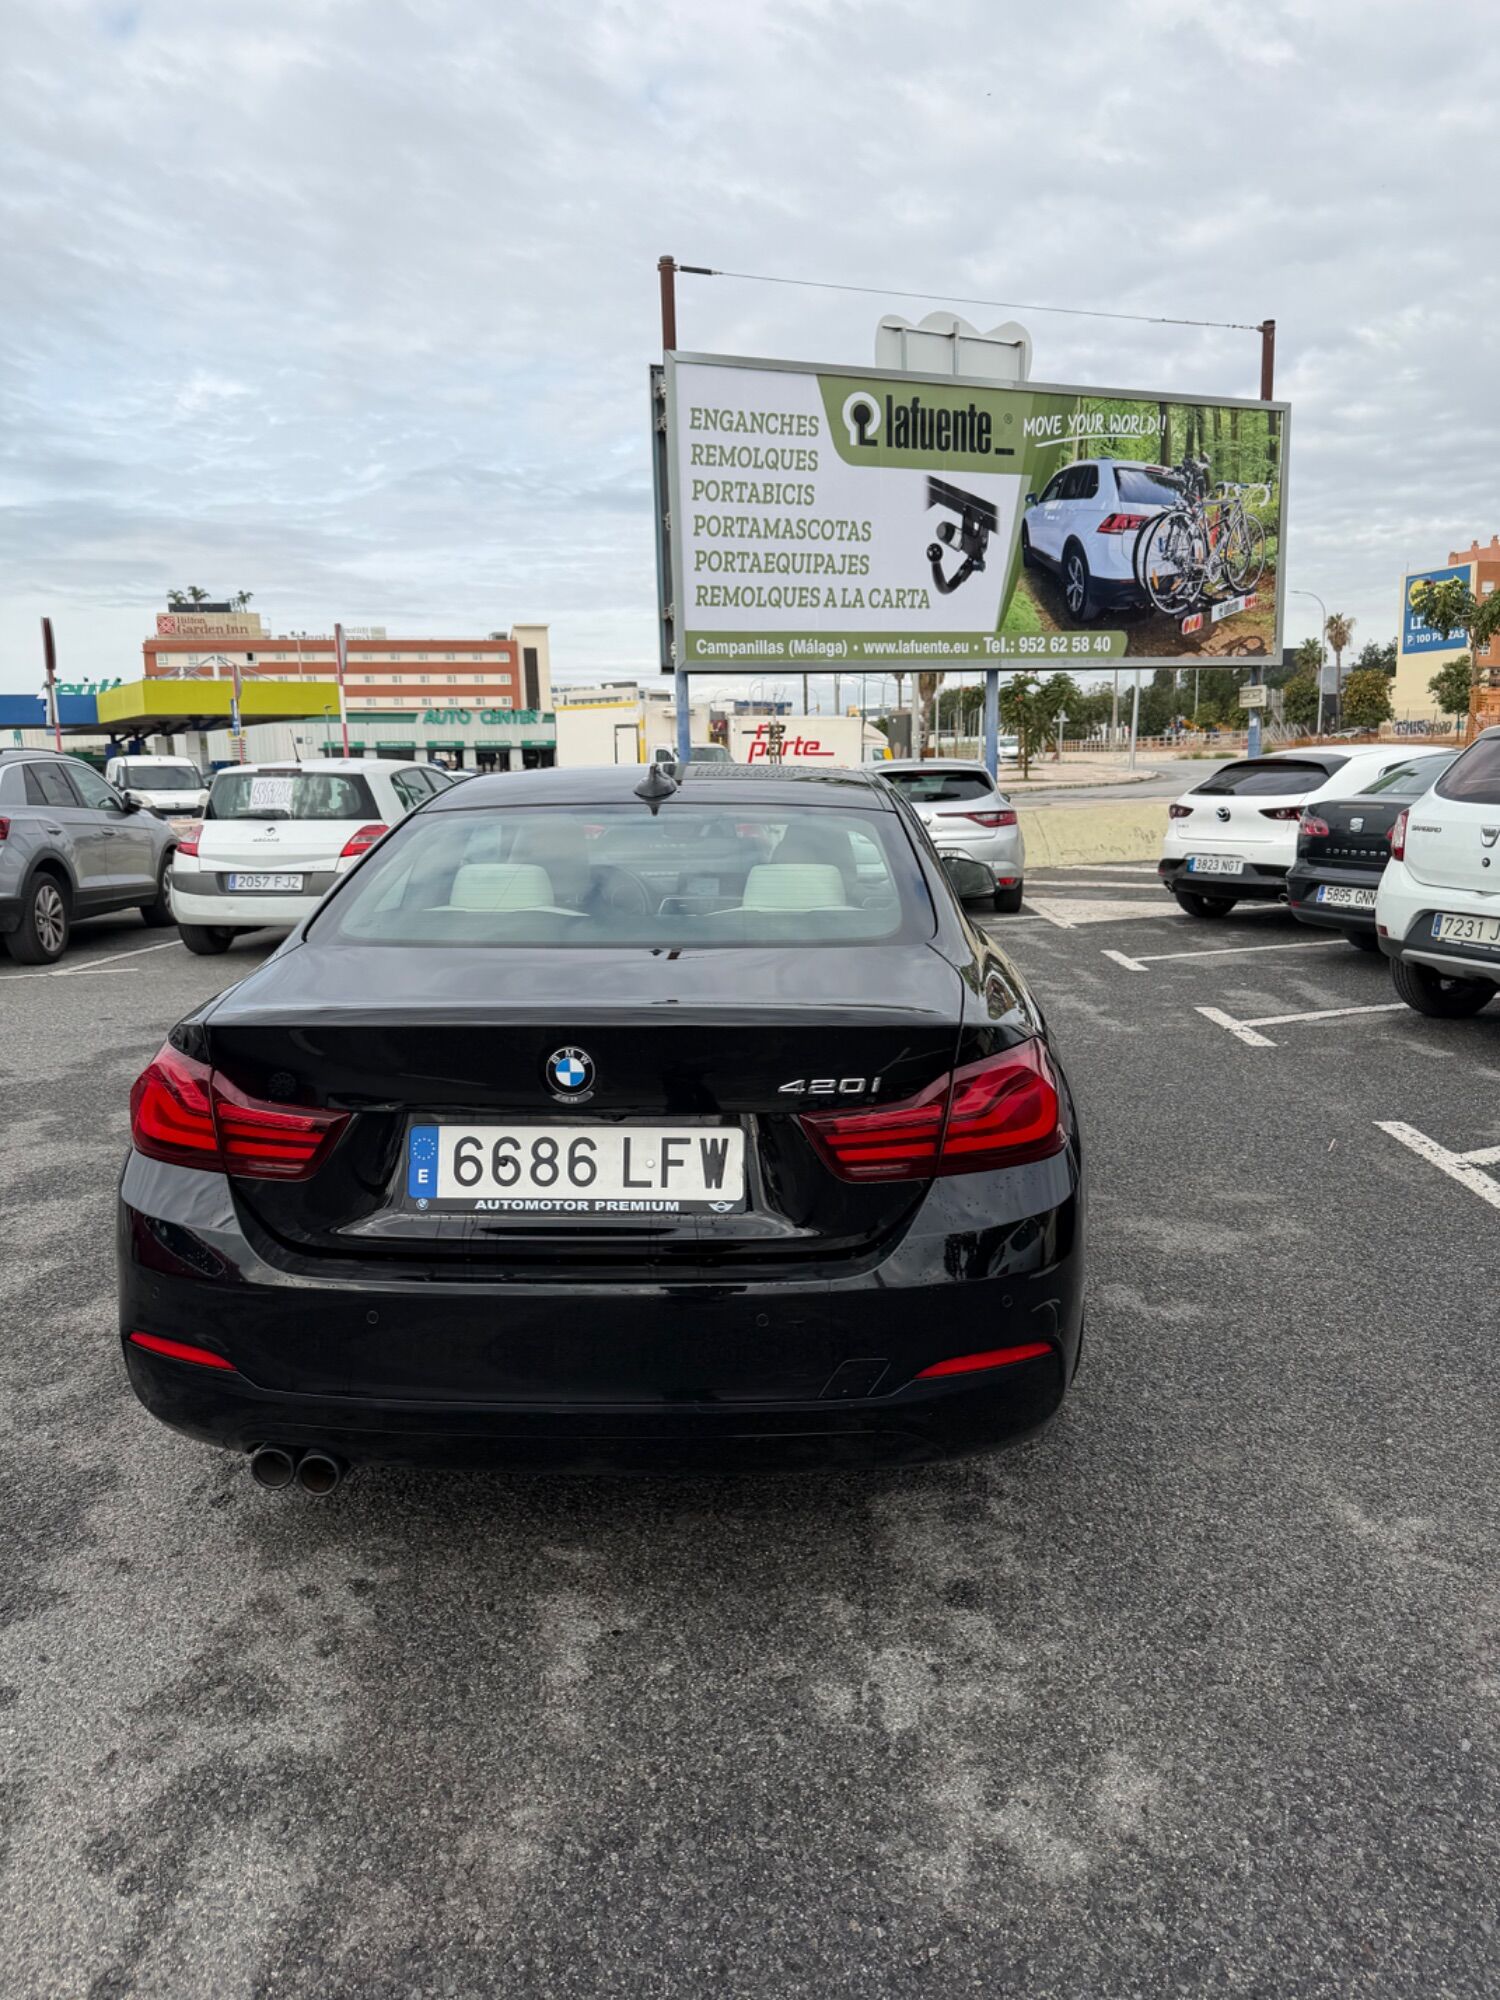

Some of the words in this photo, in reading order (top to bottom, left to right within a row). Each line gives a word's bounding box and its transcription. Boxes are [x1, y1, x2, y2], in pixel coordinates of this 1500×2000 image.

[689, 407, 819, 437] ENGANCHES
[886, 394, 992, 455] lafuente
[1023, 415, 1063, 438] MOVE
[1068, 414, 1105, 434] YOUR
[1110, 414, 1167, 437] WORLD!!
[690, 443, 819, 472] REMOLQUES
[692, 478, 815, 506] PORTABICIS
[693, 515, 872, 542] PORTAMASCOTAS
[694, 550, 870, 576] PORTAEQUIPAJES
[695, 584, 821, 609] REMOLQUES
[823, 587, 838, 608] A
[840, 587, 865, 609] LA
[868, 588, 931, 609] CARTA
[176, 622, 225, 635] Garden
[226, 623, 248, 635] Inn
[1416, 633, 1431, 644] 100
[1432, 630, 1465, 642] PLZAS
[696, 638, 785, 658] Campanillas
[789, 638, 848, 658] (Málaga)
[863, 639, 969, 654] www.lafuente.eu
[983, 636, 1015, 653] Tel.:
[1018, 636, 1046, 653] 952
[1050, 636, 1068, 653] 62
[1072, 636, 1090, 652] 58
[1093, 636, 1111, 652] 40
[423, 709, 473, 725] AUTO
[480, 709, 538, 725] CENTER
[1195, 858, 1219, 871] 3823
[1220, 860, 1242, 873] NGT
[237, 876, 270, 888] 2057
[1326, 887, 1352, 903] 5895
[1444, 917, 1484, 939] 7231
[453, 1135, 598, 1188] 6686
[622, 1136, 729, 1190] LFW
[417, 1168, 428, 1184] E
[474, 1199, 590, 1212] AUTOMOTOR
[594, 1200, 680, 1212] PREMIUM
